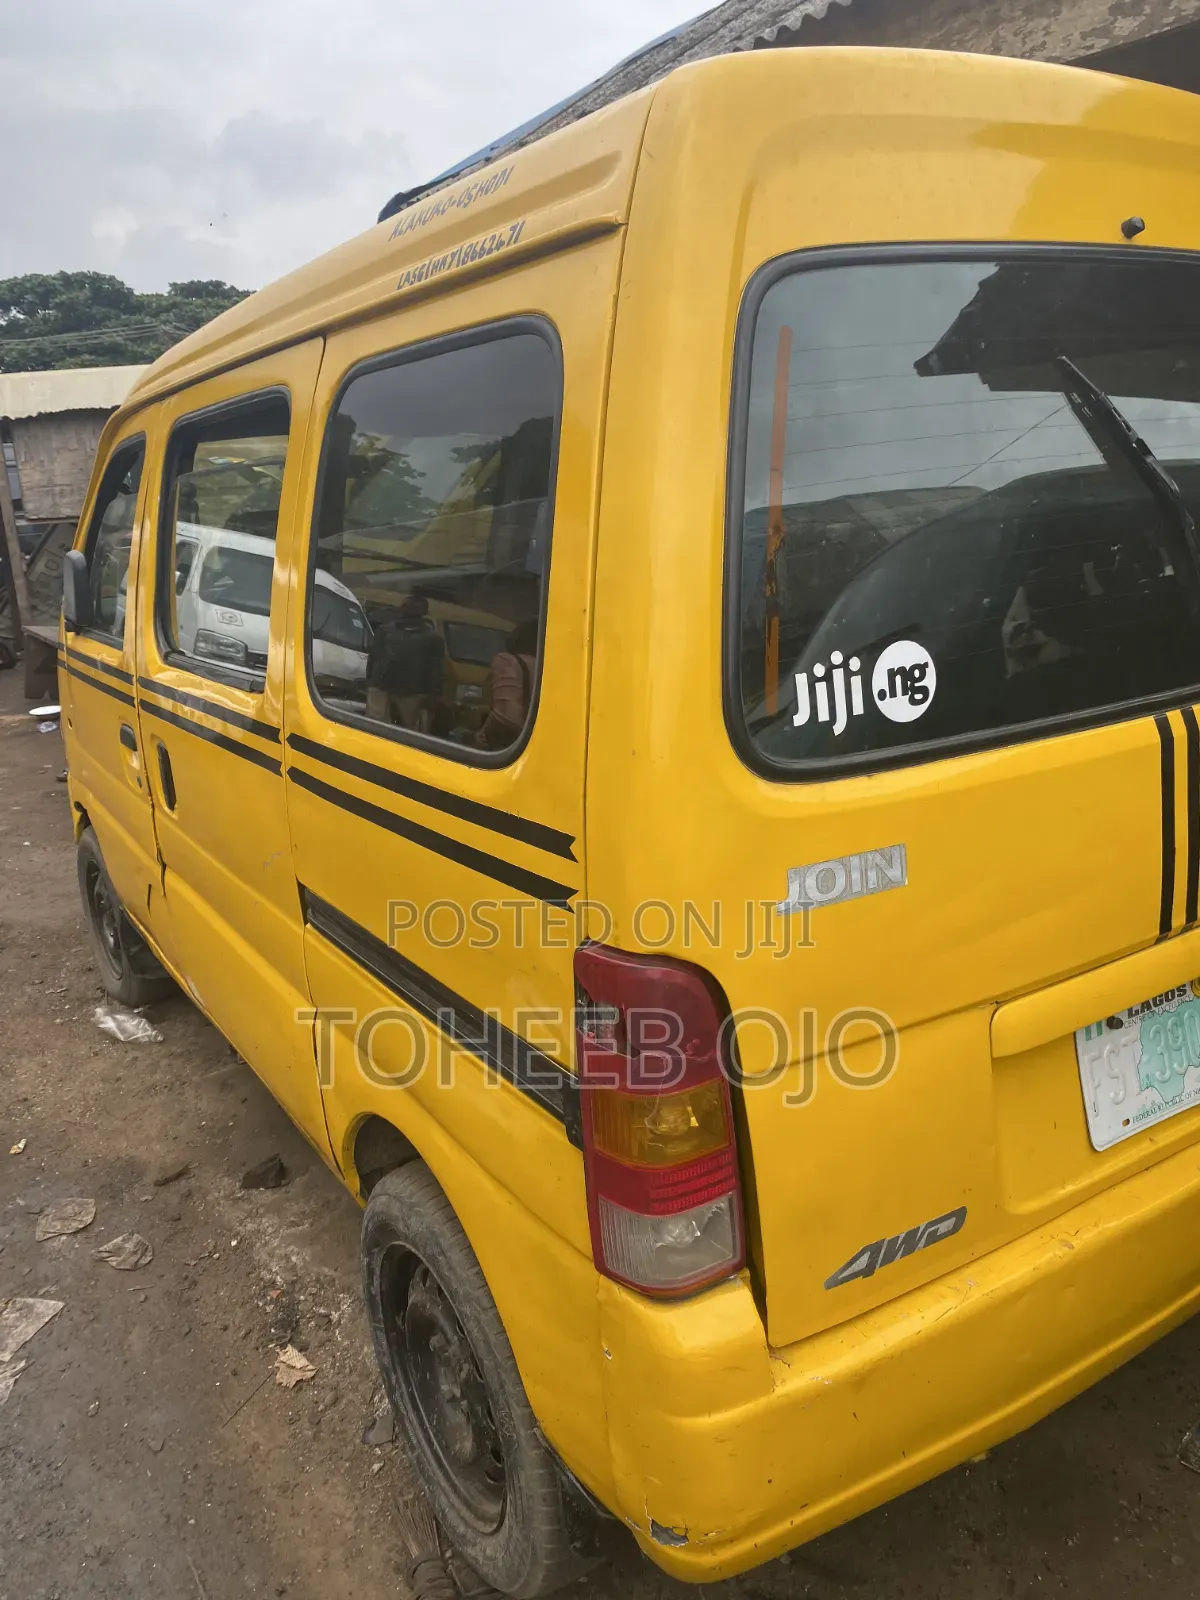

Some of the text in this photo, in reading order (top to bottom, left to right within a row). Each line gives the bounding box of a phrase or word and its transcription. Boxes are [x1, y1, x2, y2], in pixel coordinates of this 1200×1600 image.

[776, 843, 905, 916] JOIN
[1127, 983, 1188, 1020] LAGOS
[823, 1205, 968, 1291] 4WD
